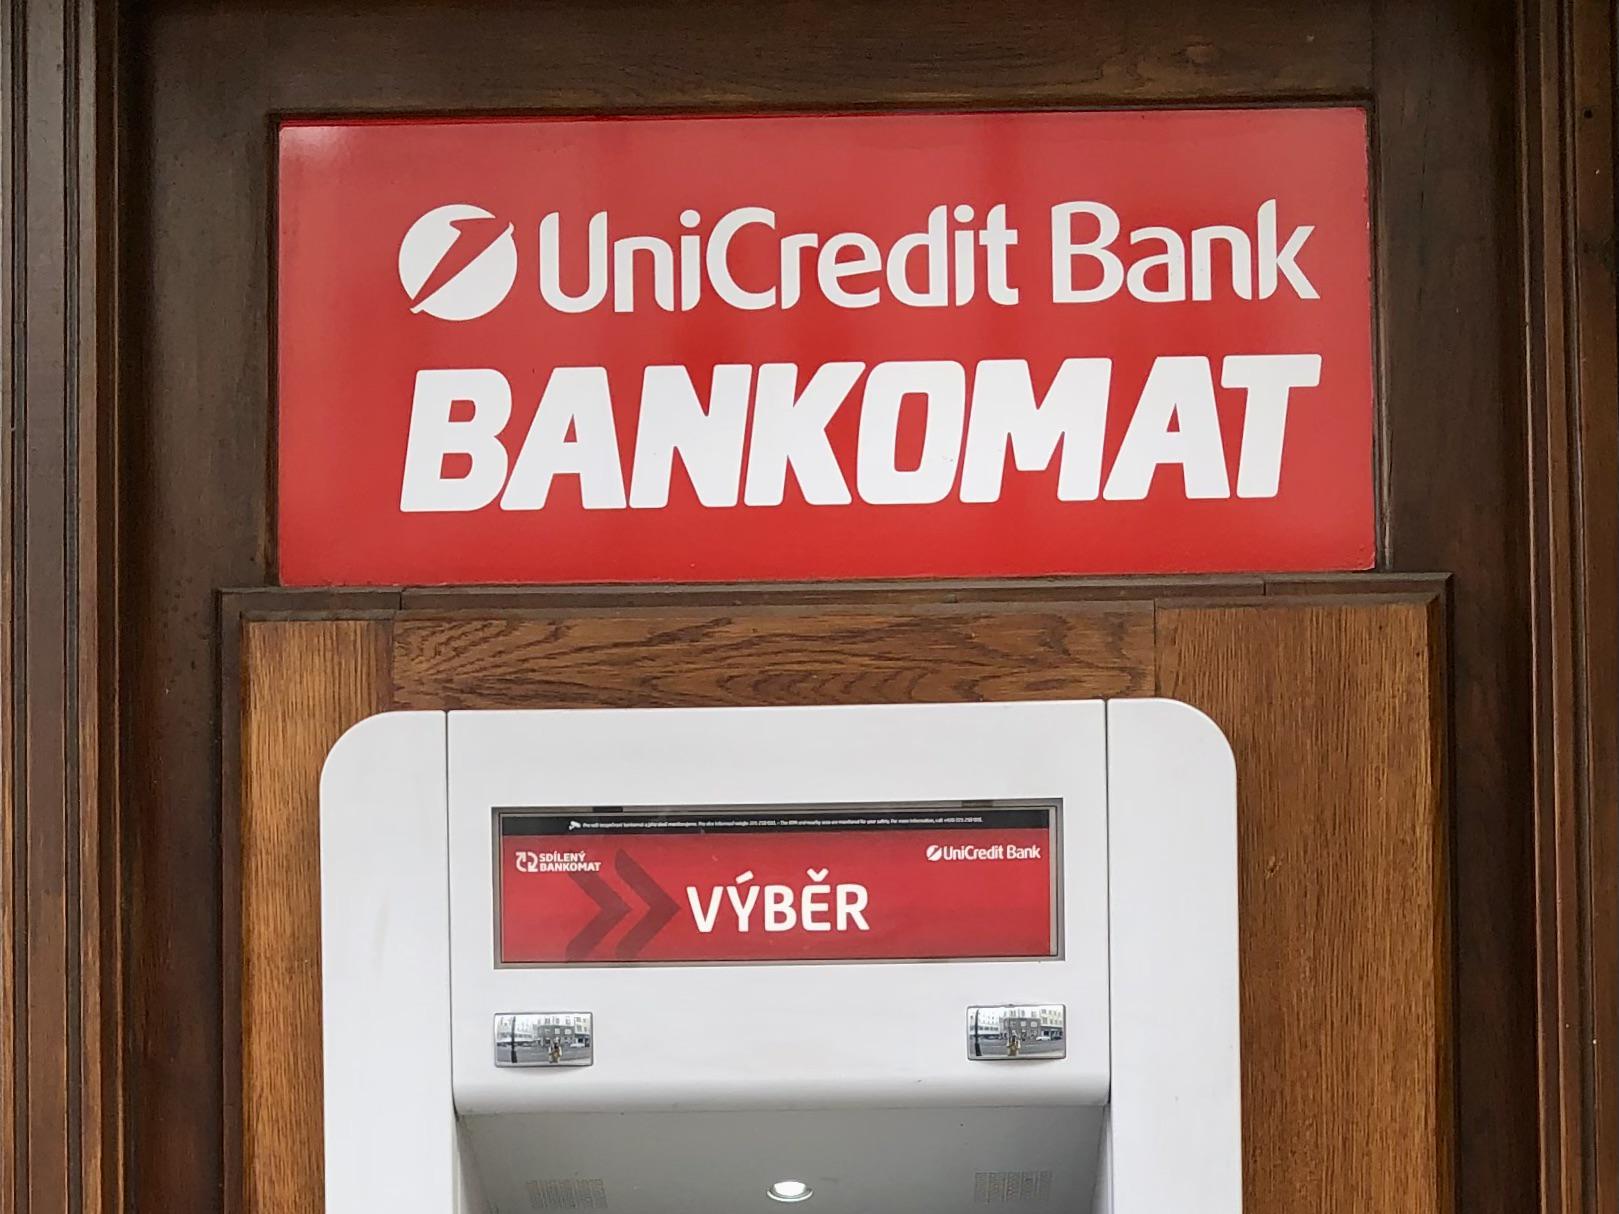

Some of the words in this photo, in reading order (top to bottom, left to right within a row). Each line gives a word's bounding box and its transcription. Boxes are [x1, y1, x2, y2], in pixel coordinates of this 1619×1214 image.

[539, 202, 1019, 314] UniCredit
[1051, 199, 1321, 306] Bank
[400, 353, 1322, 512] BANKOMAT
[539, 851, 586, 863] SDÍLENÝ
[539, 862, 602, 872] BANKOMAT
[943, 845, 1004, 861] UniCredit
[1006, 844, 1041, 859] Bank
[686, 868, 870, 933] VÝBĚR
